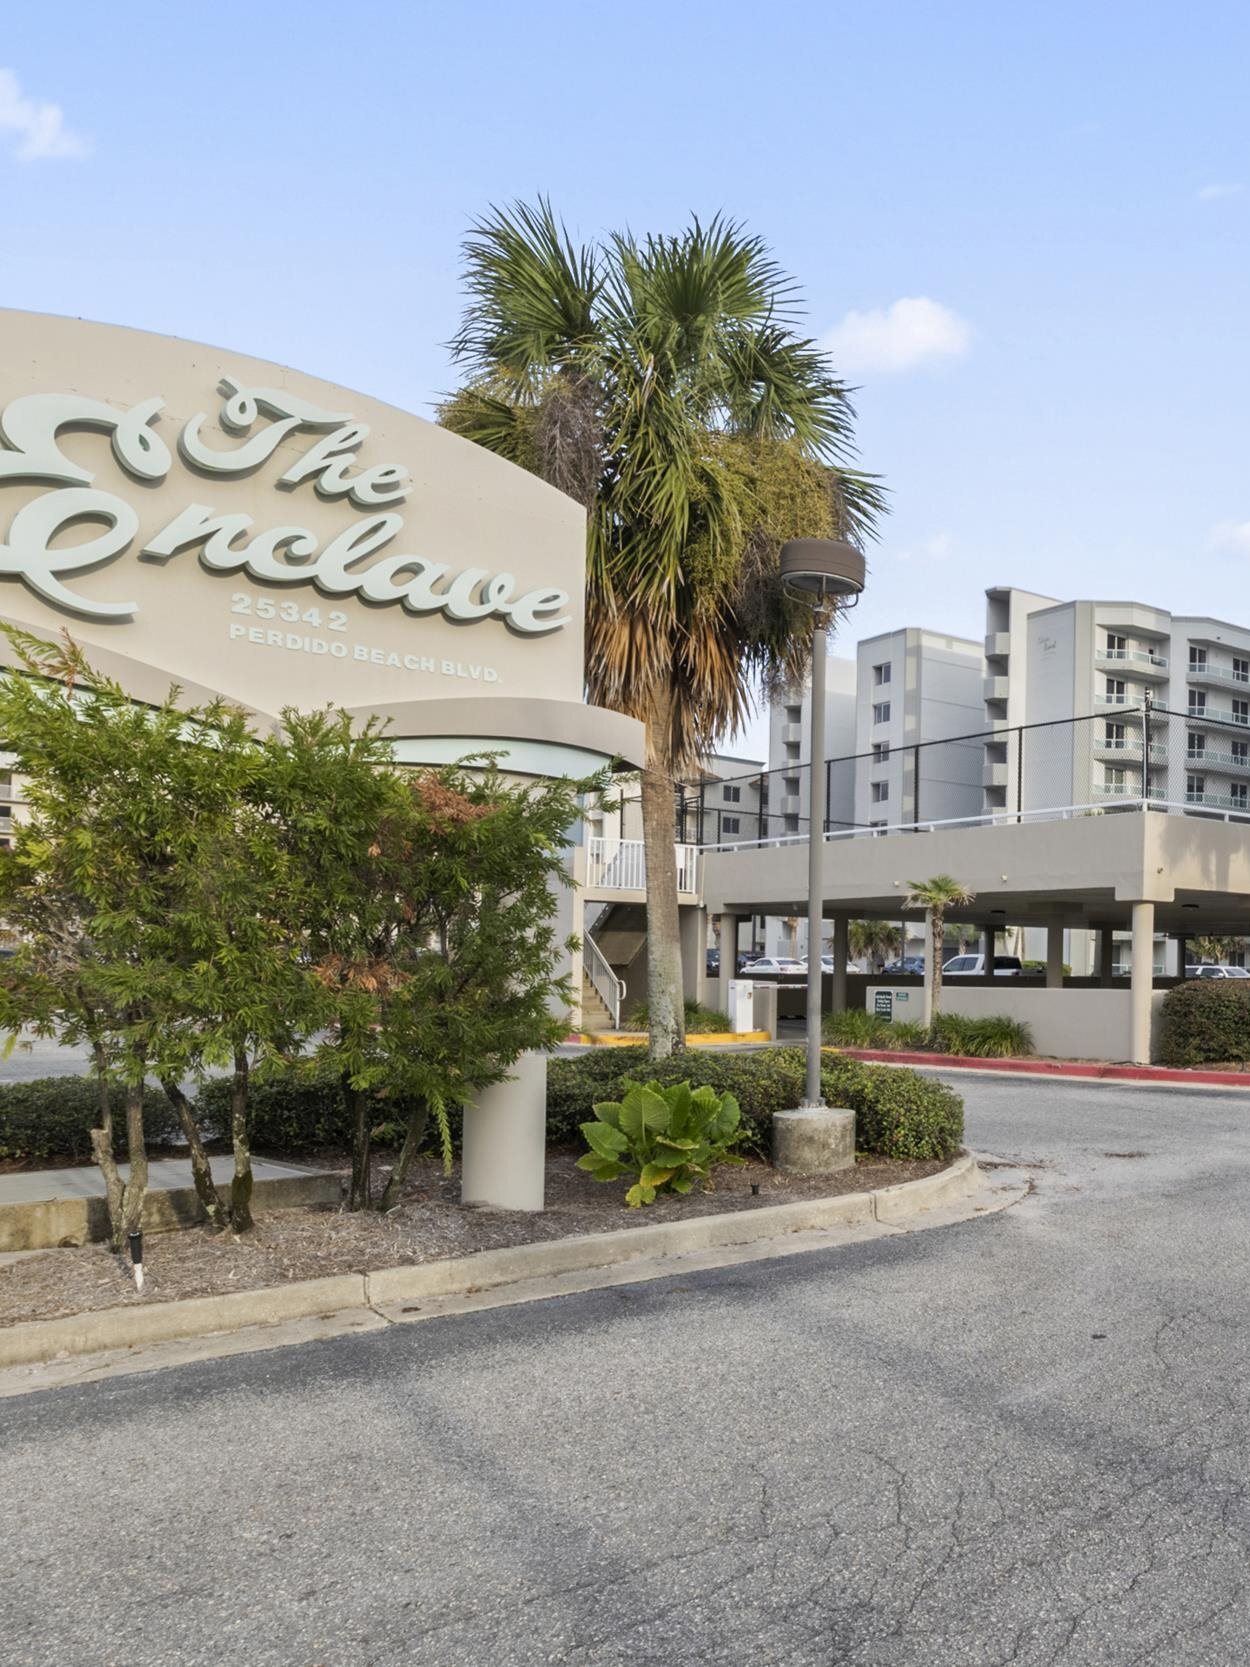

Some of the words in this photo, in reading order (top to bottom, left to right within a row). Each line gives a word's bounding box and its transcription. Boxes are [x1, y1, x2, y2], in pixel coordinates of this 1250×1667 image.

[178, 374, 414, 506] The
[0, 393, 573, 634] Enclave
[229, 623, 348, 659] PERDIDO
[352, 645, 435, 673] BEACH
[441, 660, 503, 684] BLVD.
[230, 592, 348, 632] 25342
